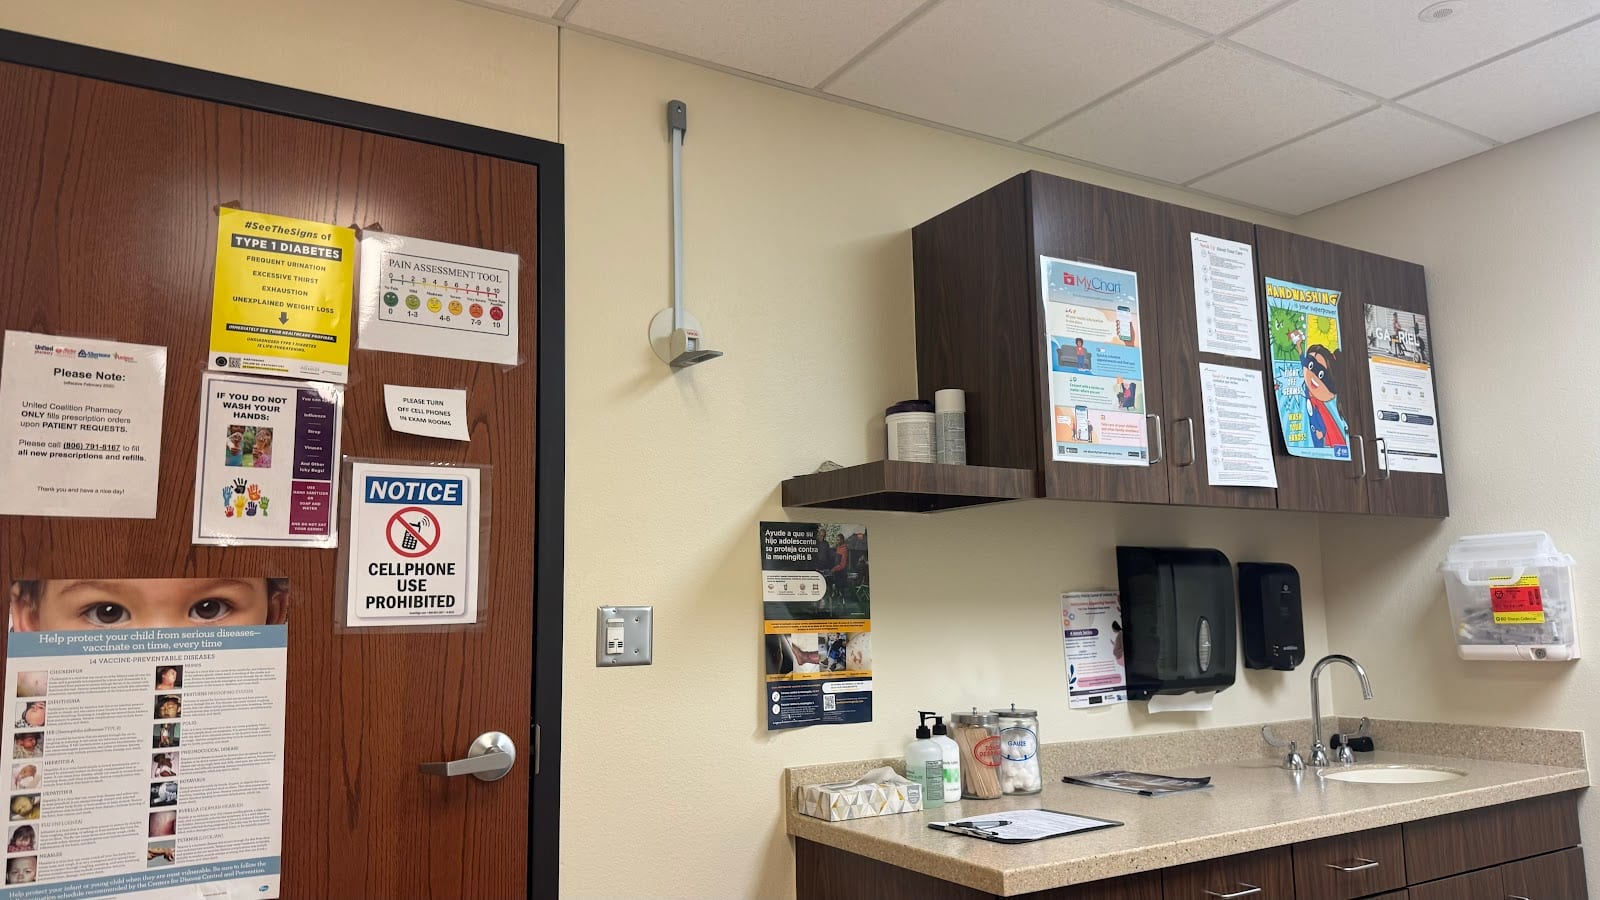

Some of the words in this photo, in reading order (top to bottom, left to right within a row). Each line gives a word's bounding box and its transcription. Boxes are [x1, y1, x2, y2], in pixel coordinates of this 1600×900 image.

[245, 221, 318, 239] #SeeTheSigns
[321, 233, 331, 241] of
[236, 236, 267, 249] TYPE
[272, 242, 276, 250] 1
[280, 242, 340, 259] DIABETES
[246, 255, 285, 266] FREQUENT
[287, 260, 326, 271] URINATION
[252, 270, 292, 281] EXCESSIVE
[294, 276, 319, 284] THIRST
[389, 259, 412, 270] PAIN
[414, 263, 475, 280] ASSESSMENT
[477, 271, 501, 283] TOOL
[1076, 275, 1120, 292] MyChart
[261, 286, 308, 296] EXHAUSTION
[1267, 283, 1338, 306] HANDWASHING
[232, 296, 284, 307] UNEXPLAINED
[287, 303, 315, 311] WEIGHT
[317, 306, 334, 314] LOSS
[54, 368, 92, 379] Please
[96, 371, 126, 381] Note:
[229, 393, 249, 401] YOU
[252, 395, 265, 403] DO
[268, 396, 287, 404] NOT
[402, 397, 425, 406] PLEASE
[22, 401, 47, 410] United
[50, 404, 83, 412] Coalition
[85, 406, 122, 415] Pharmacy
[223, 402, 251, 410] WASH
[255, 405, 280, 413] YOUR
[426, 409, 451, 417] PHONES
[21, 410, 45, 419] ONLY
[47, 412, 60, 420] fills
[61, 413, 105, 423] prescription
[233, 411, 269, 420] HANDS:
[408, 416, 426, 424] EXAM
[428, 418, 452, 426] ROOMS
[20, 422, 40, 430] upon
[42, 422, 78, 430] PATIENT
[80, 424, 128, 433] REQUESTS.
[19, 439, 46, 447] Please
[63, 442, 83, 450] (806)
[86, 443, 120, 451] 791-8167
[50, 451, 103, 460] prescriptions
[122, 454, 146, 462] refills.
[369, 480, 458, 502] NOTICE
[765, 530, 785, 538] Ayude
[765, 537, 777, 545] hijo
[368, 562, 456, 576] CELLPHONE
[397, 579, 427, 592] USE
[366, 594, 455, 609] PROHIBITED
[40, 634, 64, 644] Help
[67, 633, 103, 644] protect
[106, 632, 128, 644] your
[130, 630, 154, 641] child
[157, 630, 180, 639] from
[182, 630, 215, 638] serious
[83, 641, 130, 652] vaccinate
[148, 641, 171, 650] time,
[173, 639, 199, 649] every
[202, 640, 222, 648] time
[99, 656, 183, 664] VACCINE-PREVENTABLE
